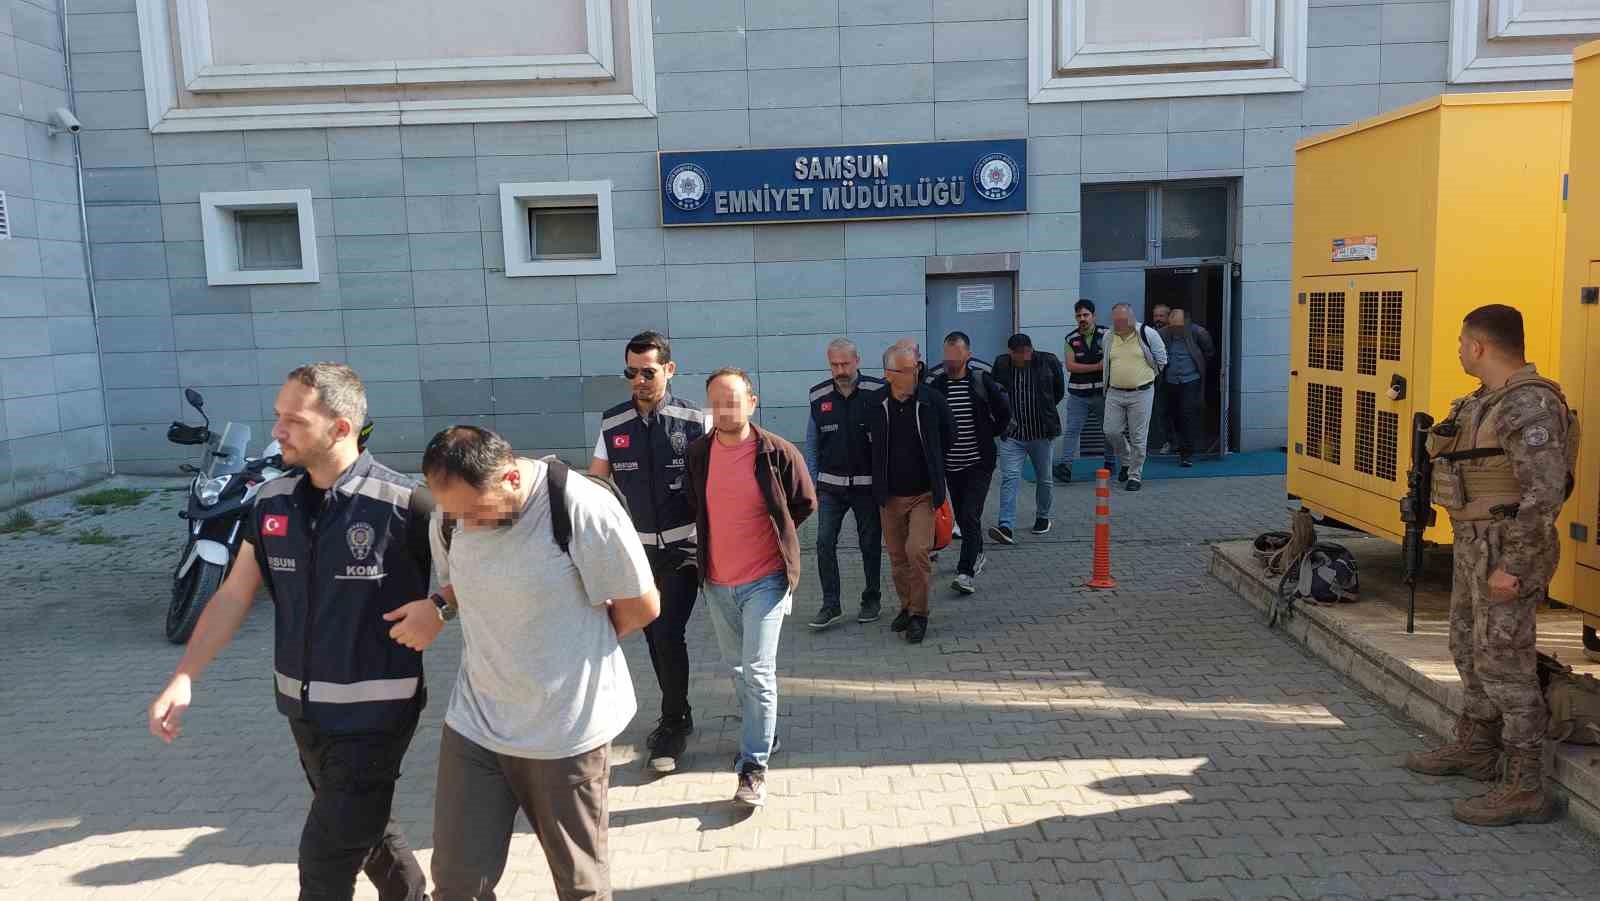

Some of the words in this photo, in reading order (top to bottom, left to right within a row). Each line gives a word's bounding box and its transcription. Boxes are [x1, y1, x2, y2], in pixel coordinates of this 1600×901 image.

[795, 155, 889, 180] SAMSUN
[714, 184, 814, 214] EMNİYET
[822, 176, 966, 211] MÜDÜRLÜĞÜ
[346, 565, 379, 576] KOM
